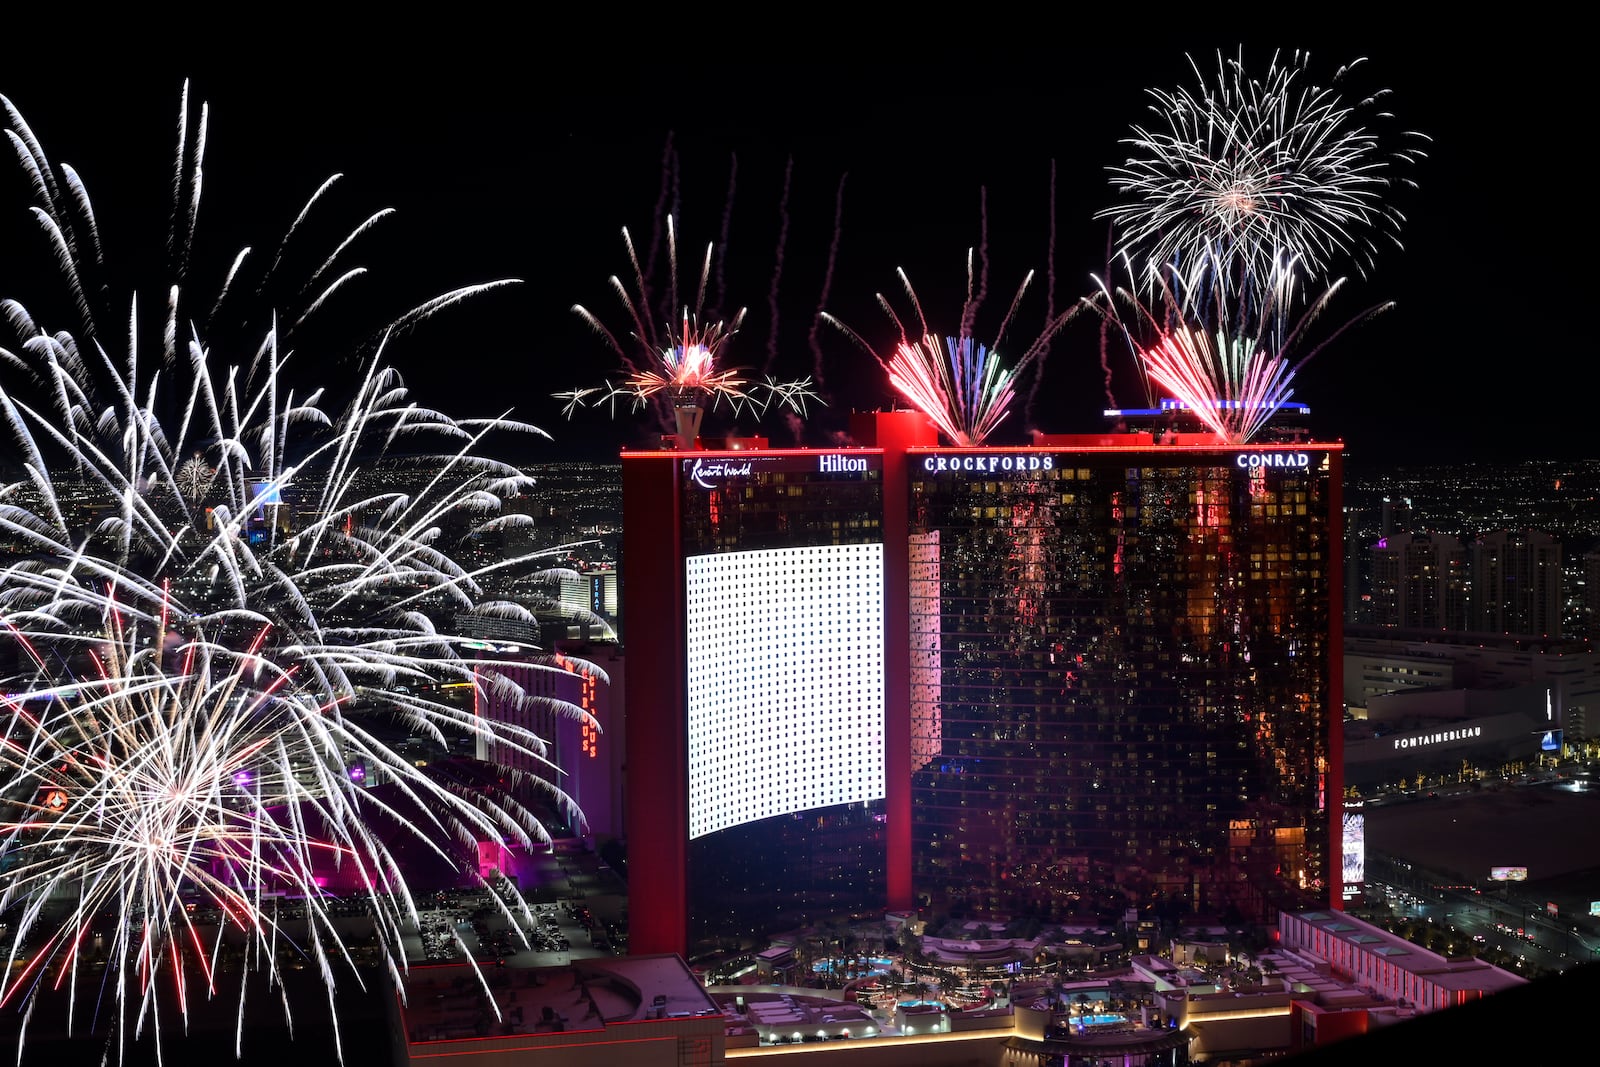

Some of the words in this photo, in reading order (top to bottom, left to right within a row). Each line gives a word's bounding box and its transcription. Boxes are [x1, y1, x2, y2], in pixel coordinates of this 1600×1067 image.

[819, 454, 868, 472] Hilton
[925, 457, 1053, 472] CROCKFORDS
[1237, 454, 1309, 467] CONRAD
[691, 458, 723, 489] Resorts
[724, 463, 752, 476] World
[1394, 727, 1481, 749] FONTAINEBLEAU
